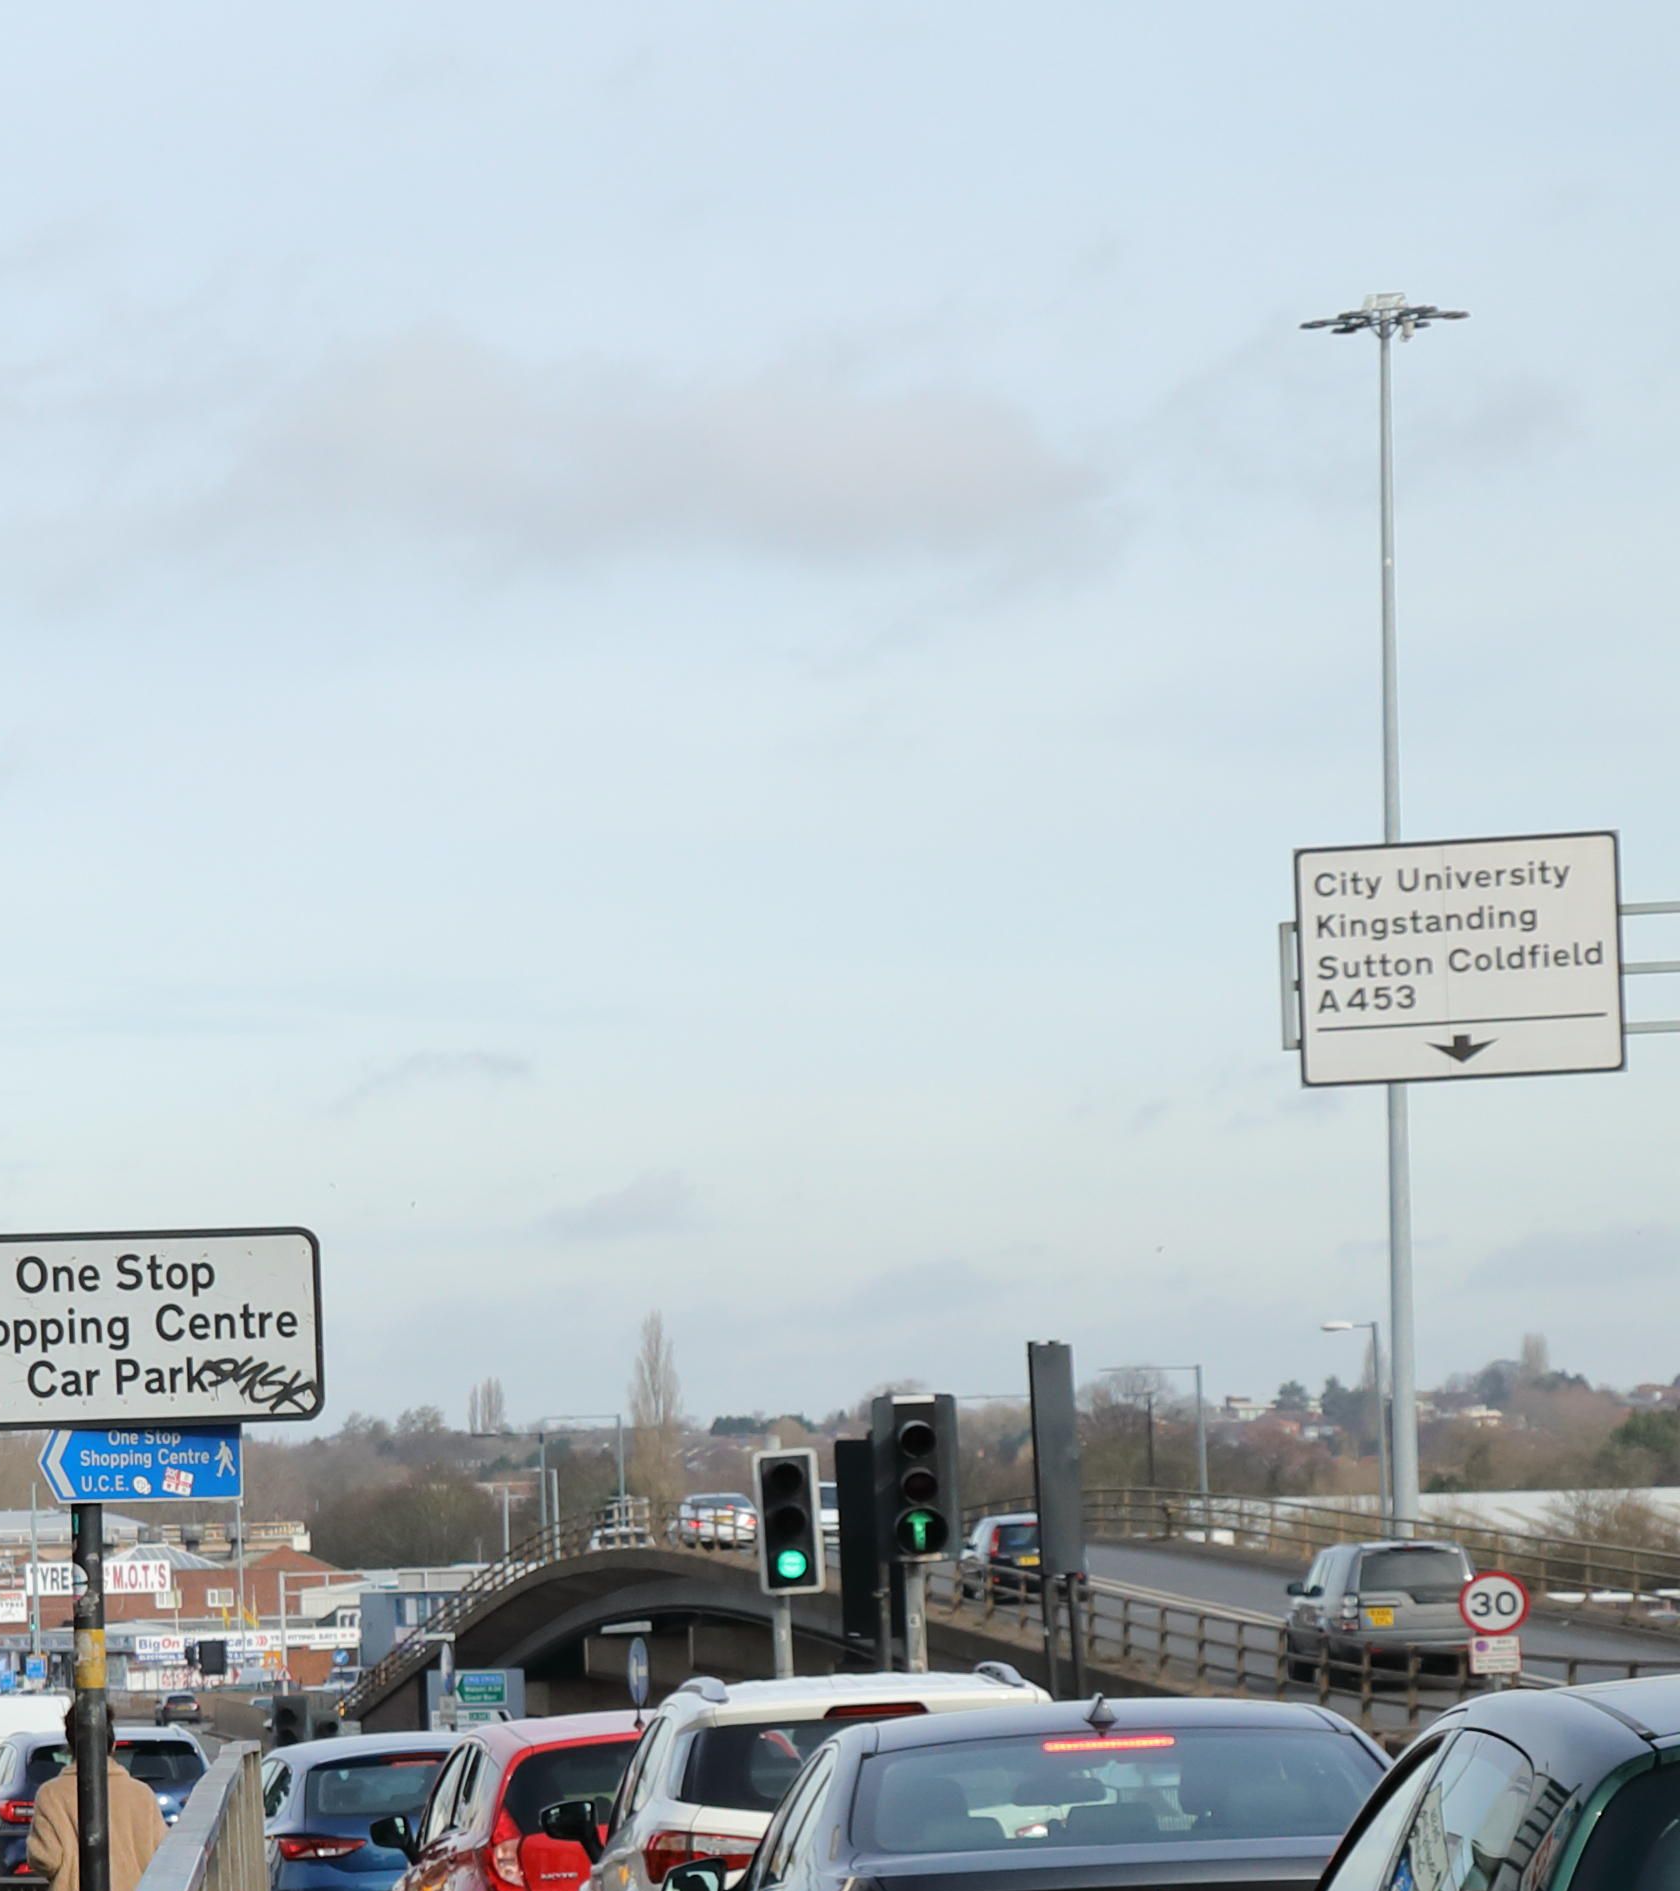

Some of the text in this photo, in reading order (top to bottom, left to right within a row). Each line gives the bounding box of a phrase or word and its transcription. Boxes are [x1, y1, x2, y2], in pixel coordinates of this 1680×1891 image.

[1314, 862, 1570, 900] City University
[1316, 906, 1538, 940] Kingstanding
[1317, 941, 1603, 981] Sutton Coldfield
[16, 1254, 215, 1297] One Stop
[155, 1302, 298, 1342] Centre
[27, 1360, 100, 1399] Car
[116, 1357, 209, 1395] Park
[108, 1430, 181, 1448] One Stop
[80, 1448, 210, 1468] Shopping Centre
[81, 1476, 129, 1492] U.C.E.
[1471, 1591, 1517, 1616] 30
